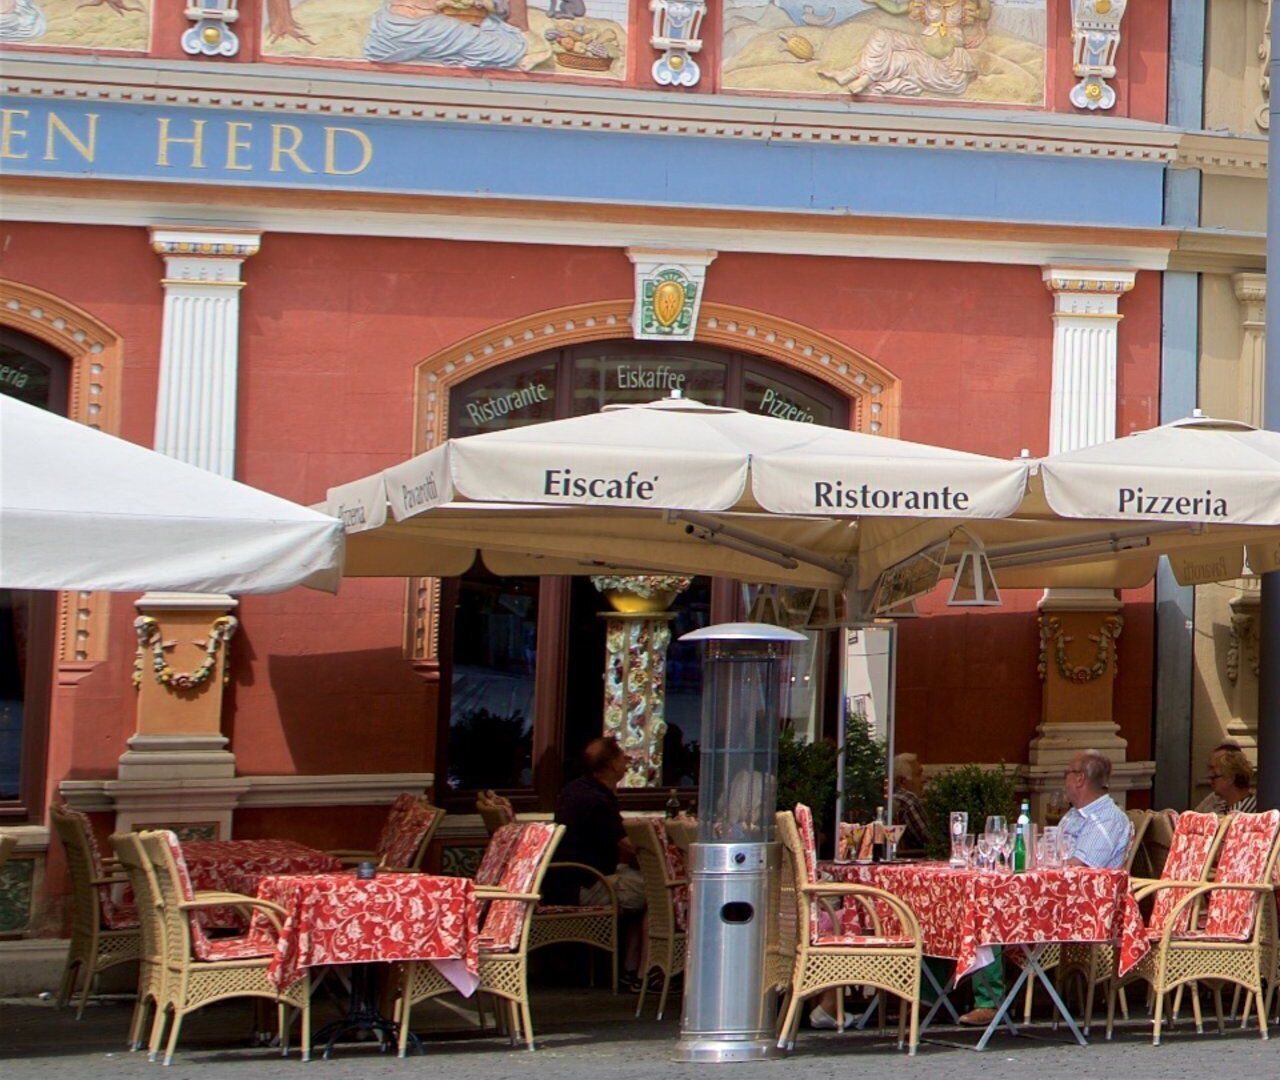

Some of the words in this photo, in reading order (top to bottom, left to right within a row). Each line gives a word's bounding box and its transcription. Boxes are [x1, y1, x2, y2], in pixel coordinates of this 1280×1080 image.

[0, 108, 100, 163] EN
[155, 117, 374, 176] HERD
[616, 364, 686, 390] Eiskaffee
[466, 381, 549, 426] Ristorante
[814, 481, 970, 511] Ristorante
[1118, 487, 1229, 517] Pizzeria
